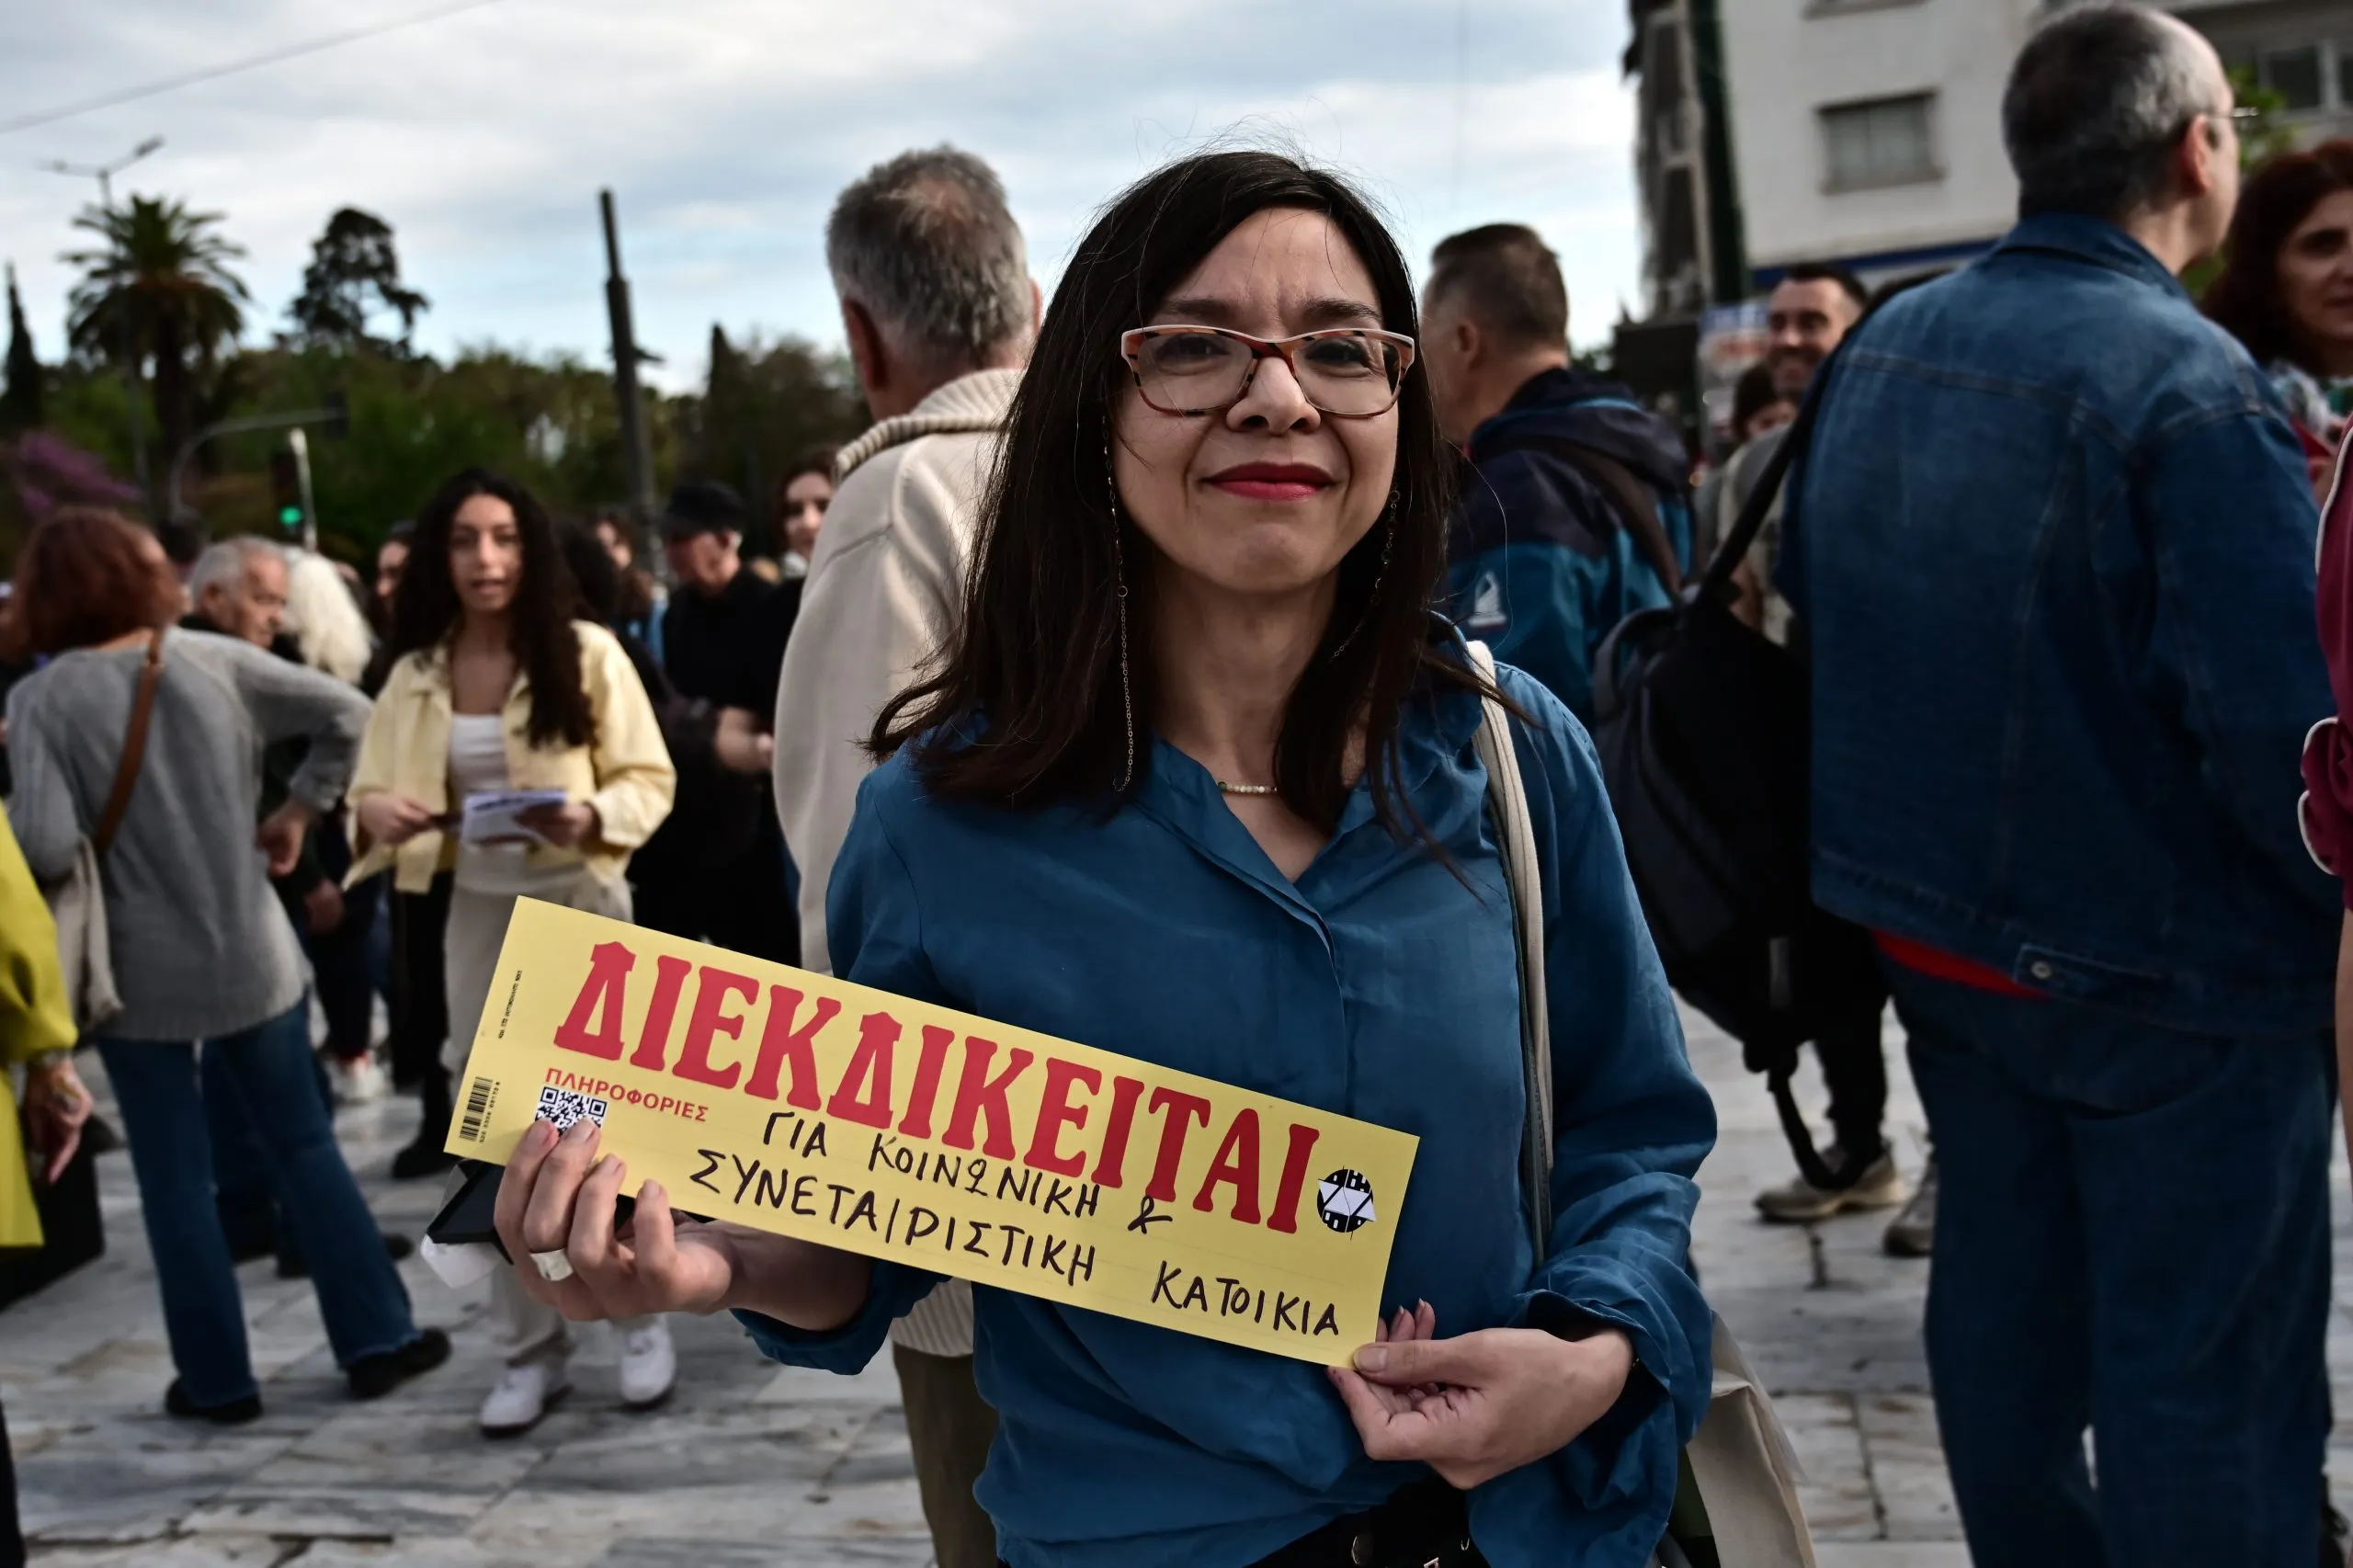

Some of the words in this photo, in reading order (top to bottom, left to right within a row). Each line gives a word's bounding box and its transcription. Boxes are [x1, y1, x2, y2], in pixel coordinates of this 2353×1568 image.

[545, 1067, 710, 1122] ΠΛΗΡΟΦΟΡΙΕΣ
[553, 941, 1320, 1234] ΔΙΕΚΔΙΚΕΙΤΑΙ
[689, 1149, 1095, 1286] ΣΥΝΕΤΑΙΡΙΣΤΙΚΗ
[1151, 1260, 1339, 1335] ΚΑΤΟΙΚΙΑ
[763, 1111, 827, 1158] ΓΙΑ
[869, 1132, 1100, 1218] ΚΟΙΝΩΝΙΚΗ
[1127, 1195, 1173, 1234] &
